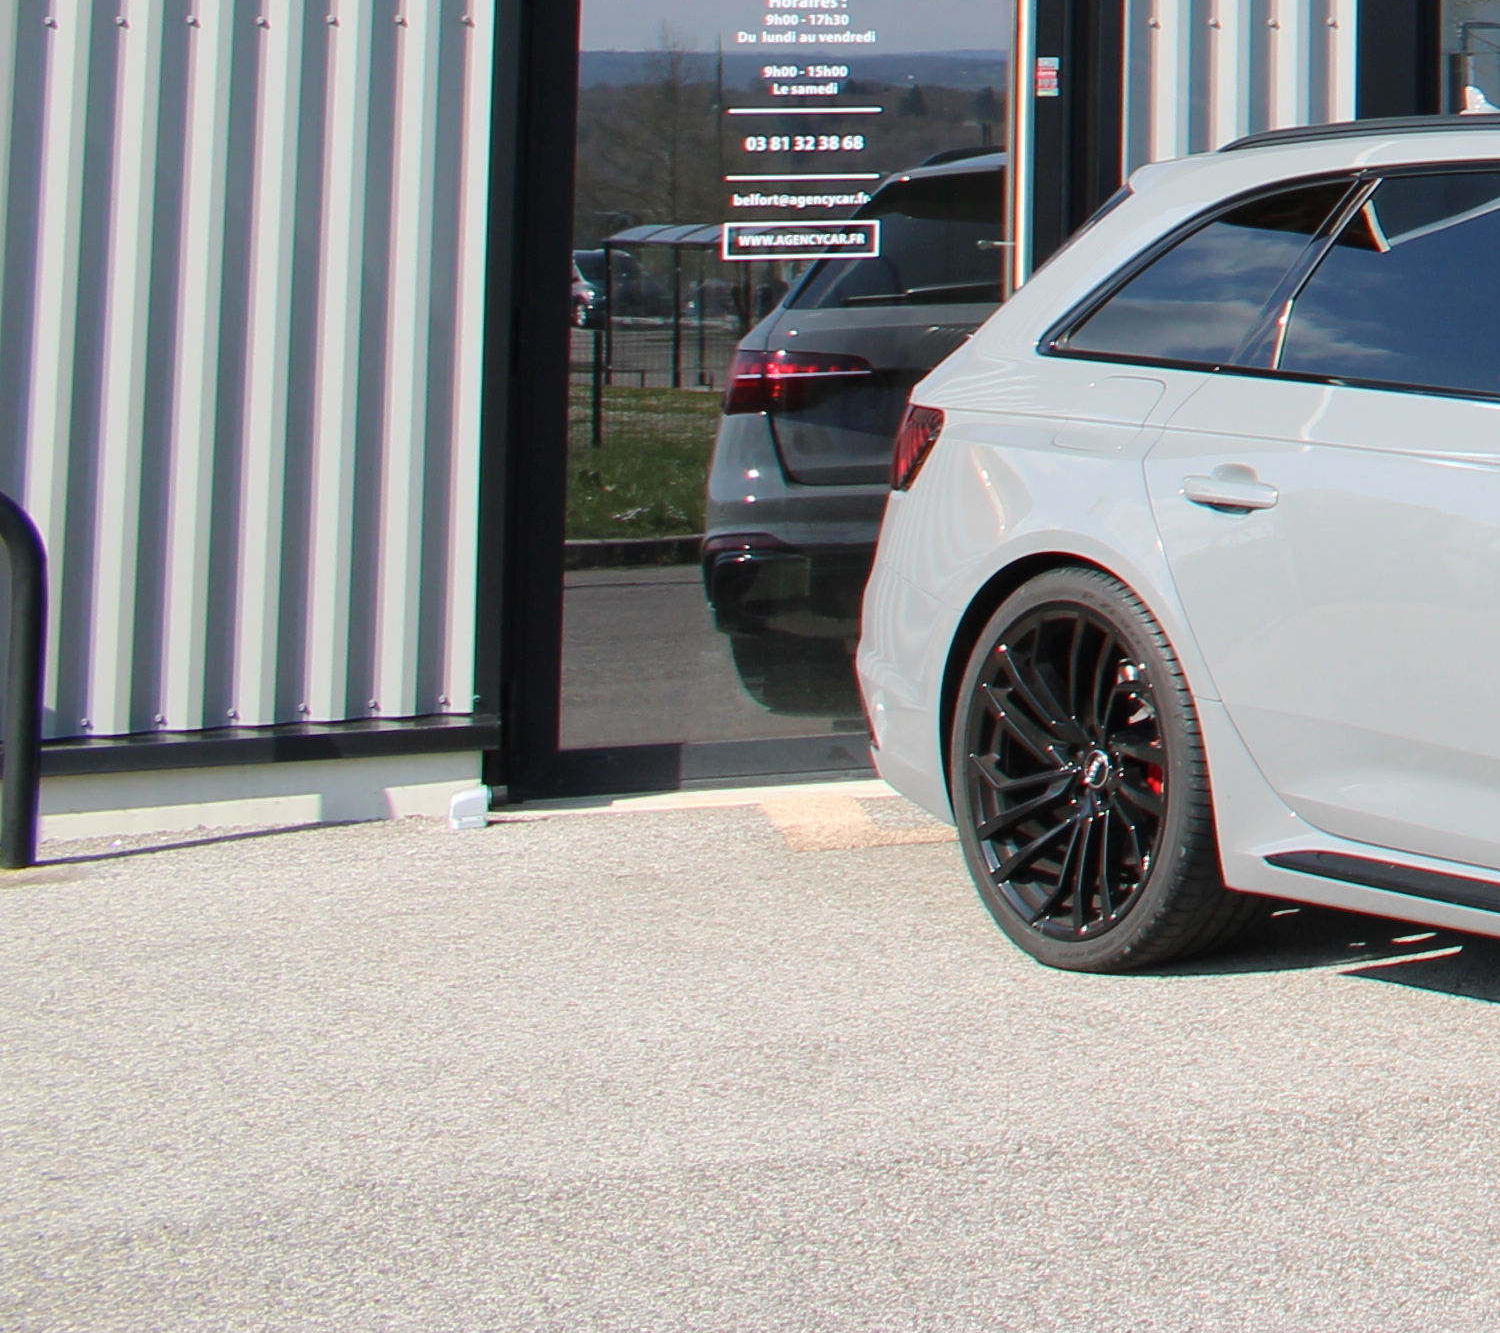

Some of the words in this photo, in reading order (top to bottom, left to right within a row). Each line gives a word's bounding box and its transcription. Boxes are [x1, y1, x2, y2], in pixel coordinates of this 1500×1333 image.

[765, 13, 799, 26] 9h00
[809, 13, 850, 26] 17h30
[736, 31, 757, 43] Du
[762, 30, 797, 43] lundi
[799, 33, 816, 43] au
[818, 30, 877, 43] vendredi
[762, 65, 798, 78] 9h00
[807, 65, 849, 78] 15h00
[772, 83, 788, 95] Le
[789, 82, 838, 95] samedi
[744, 136, 767, 152] 03
[768, 136, 790, 151] 81
[793, 136, 816, 151] 32
[816, 136, 840, 151] 38
[842, 135, 865, 150] 68
[731, 191, 868, 208] belfort@agencycar.fr
[737, 233, 866, 247] WWW.AGENCYCAR.FR
